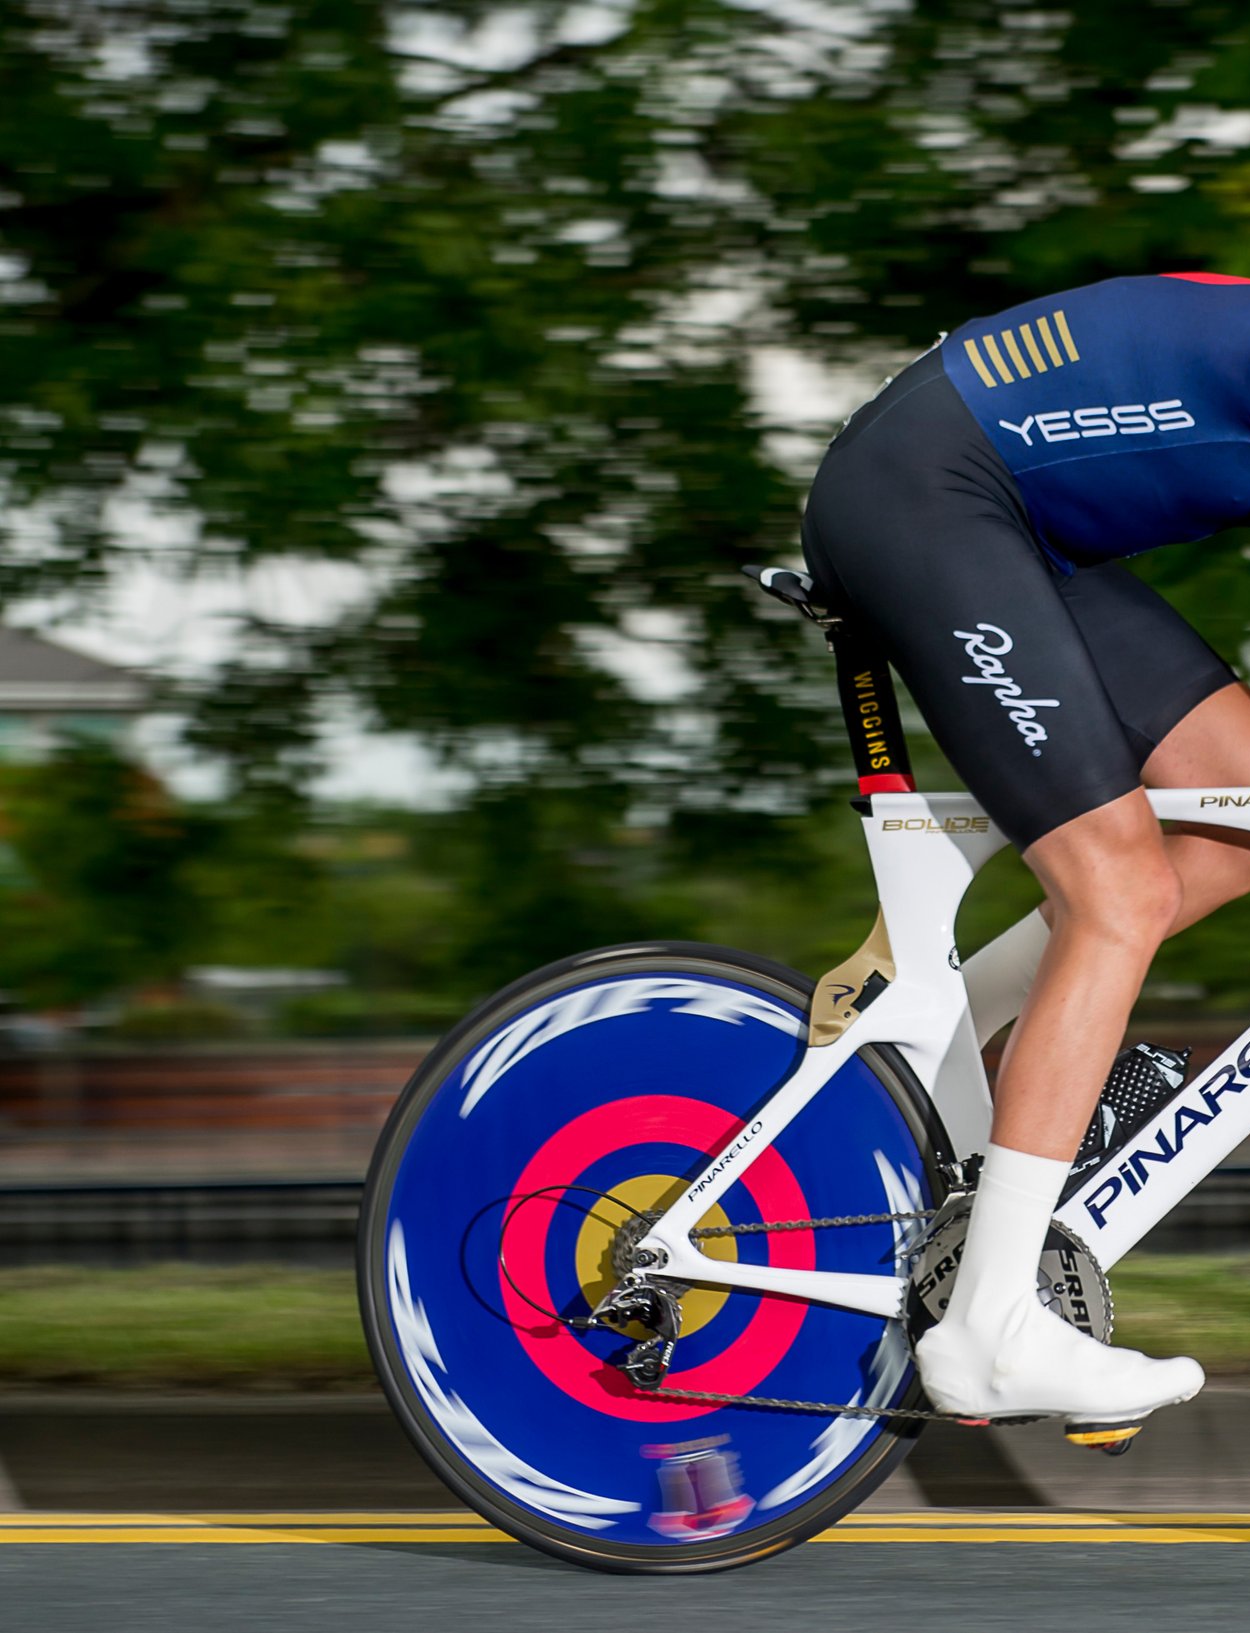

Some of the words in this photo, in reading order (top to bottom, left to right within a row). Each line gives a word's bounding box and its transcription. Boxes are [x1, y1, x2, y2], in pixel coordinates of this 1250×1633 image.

[999, 399, 1196, 446] YESSS
[853, 670, 891, 770] WIGGINS
[881, 816, 991, 833] BOLIDE
[687, 1120, 763, 1203] PINARELLO
[1058, 1248, 1095, 1338] SRA
